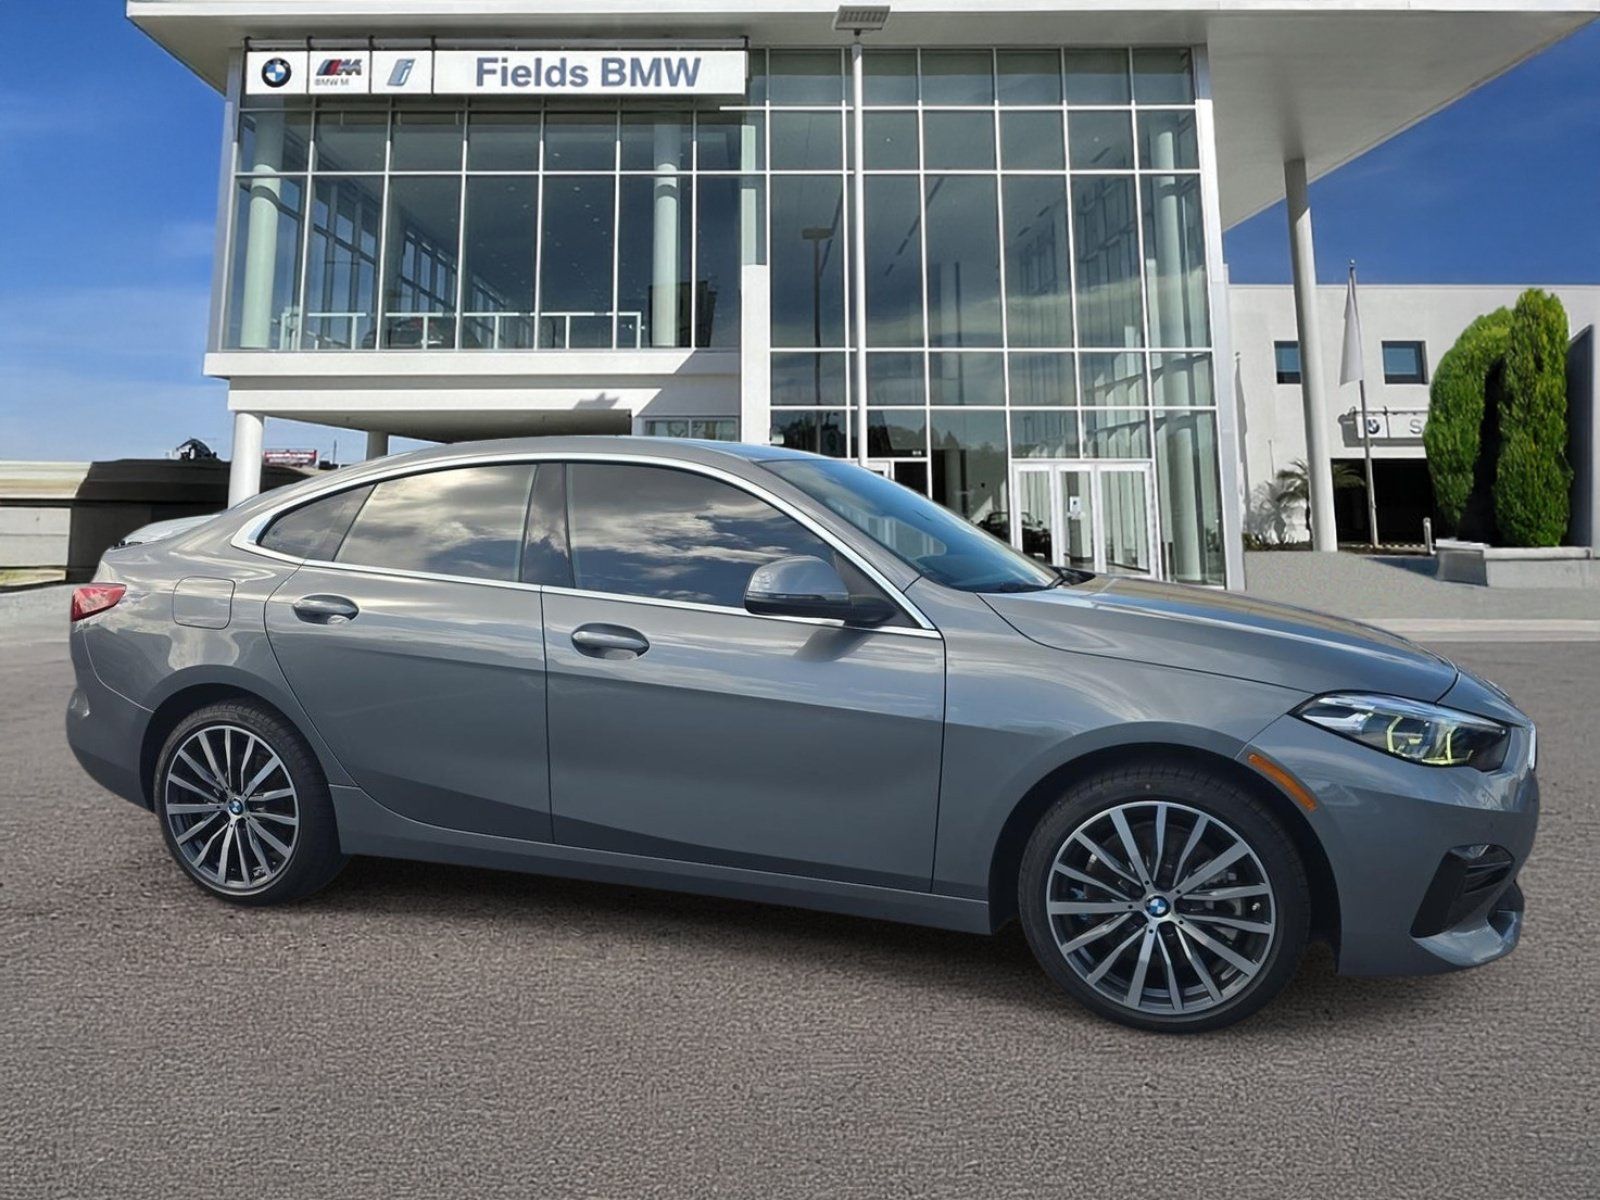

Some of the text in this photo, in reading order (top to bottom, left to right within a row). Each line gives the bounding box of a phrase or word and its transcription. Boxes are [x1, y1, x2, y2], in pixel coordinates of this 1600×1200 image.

[476, 57, 702, 87] Fields BMW
[314, 78, 338, 86] BMW
